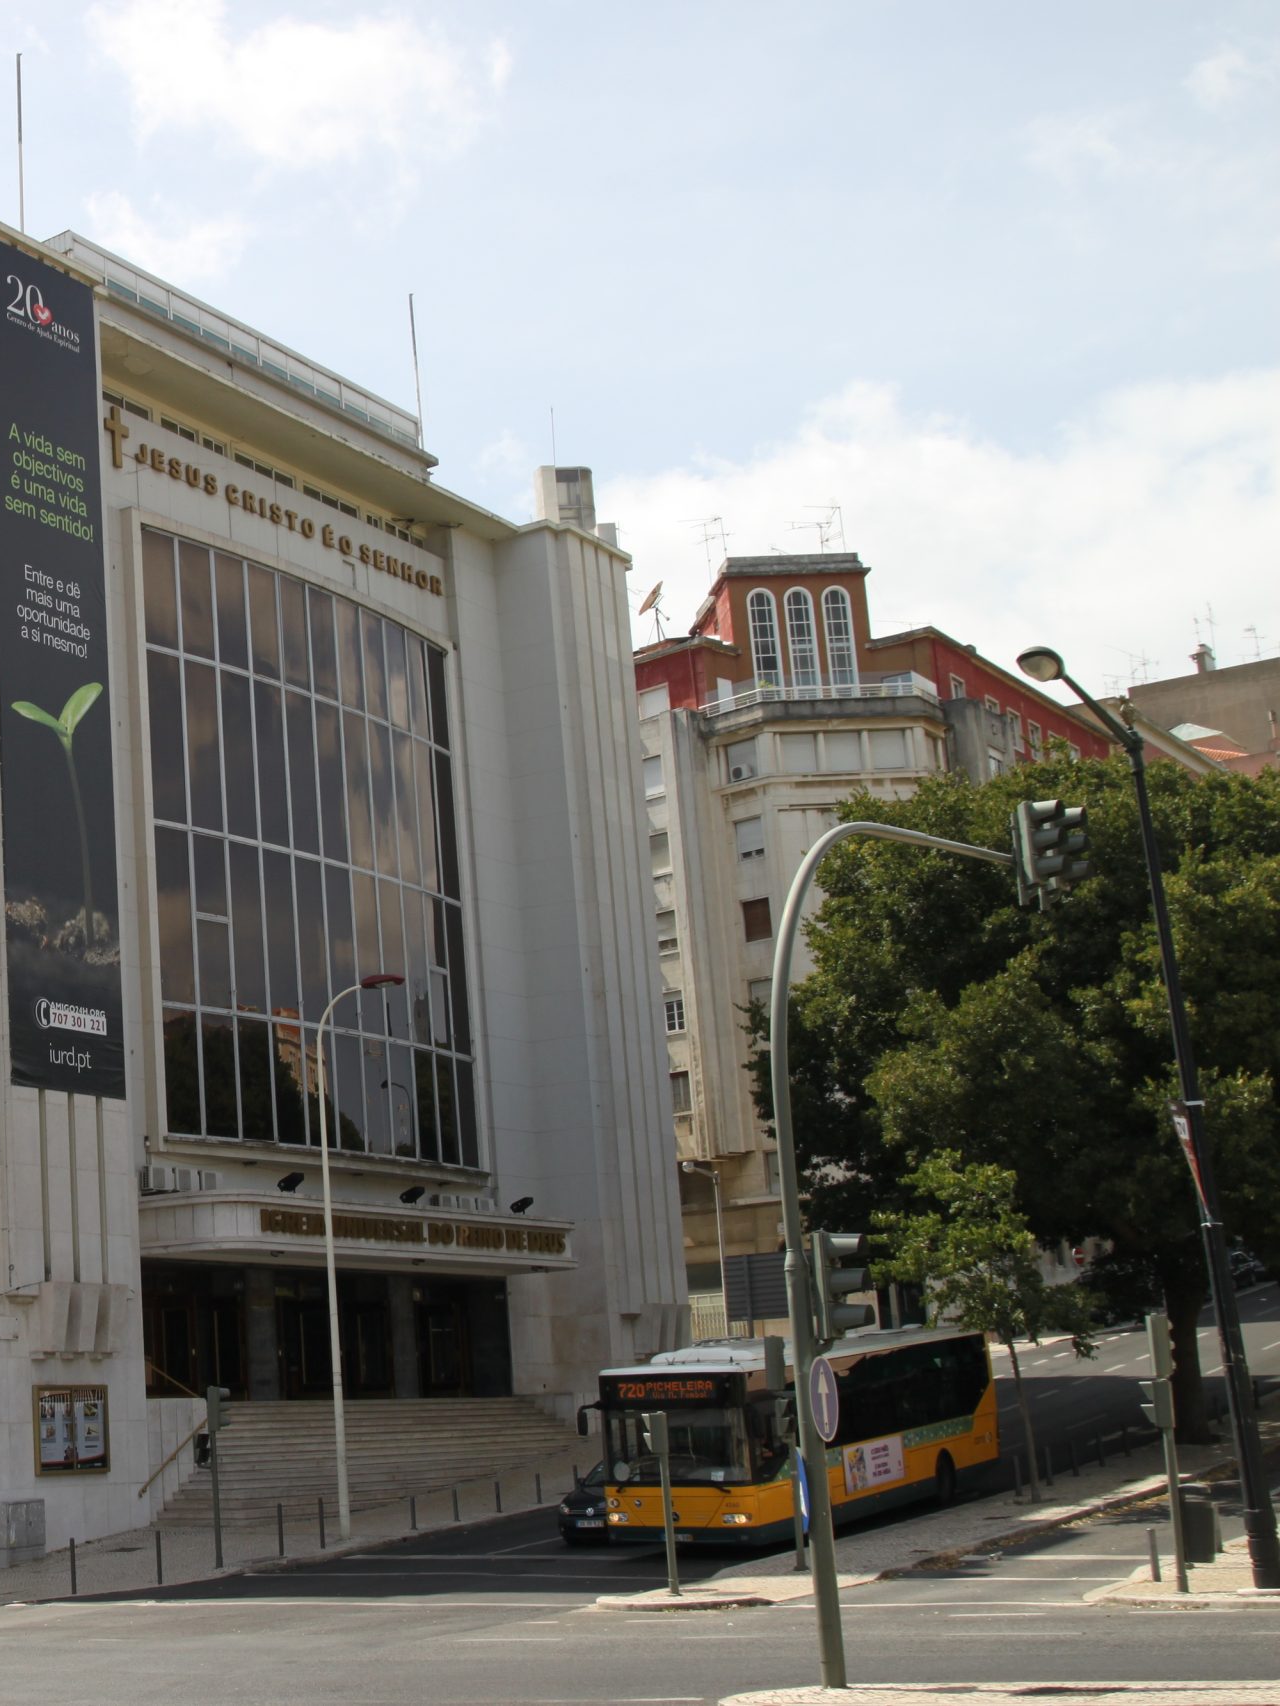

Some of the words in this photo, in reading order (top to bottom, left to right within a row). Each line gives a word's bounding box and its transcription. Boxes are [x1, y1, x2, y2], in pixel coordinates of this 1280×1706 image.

[7, 275, 43, 323] 20
[52, 321, 79, 343] anos
[7, 312, 26, 327] Centro
[28, 321, 35, 330] de
[37, 327, 52, 340] Ajuda
[53, 334, 79, 353] Espiritual
[8, 423, 20, 443] A
[24, 431, 53, 457] vida
[57, 446, 85, 471] sem
[13, 450, 84, 492] objectivos
[11, 470, 20, 489] é
[24, 479, 55, 504] uma
[59, 492, 87, 517] vida
[5, 495, 35, 519] sem
[40, 509, 94, 543] sentido!
[135, 443, 218, 495] JESUS
[225, 483, 315, 539] CRISTO
[339, 536, 353, 555] O
[359, 543, 443, 596] SENHOR
[24, 564, 53, 589] Entre
[56, 580, 63, 592] e
[66, 581, 80, 599] dê
[26, 588, 52, 608] mais
[55, 598, 80, 618] uma
[17, 604, 90, 640] oportunidade
[21, 625, 29, 639] a
[31, 627, 40, 642] si
[43, 633, 87, 659] mesmo!
[50, 1001, 106, 1018] AMIGO24H.ORG
[52, 1012, 68, 1025] 707
[71, 1016, 86, 1029] 301
[90, 1019, 104, 1032] 221
[49, 1042, 92, 1073] iurd.pt
[428, 1222, 454, 1245] DO
[618, 1383, 645, 1399] 720
[646, 1380, 713, 1391] PICHELEIRA
